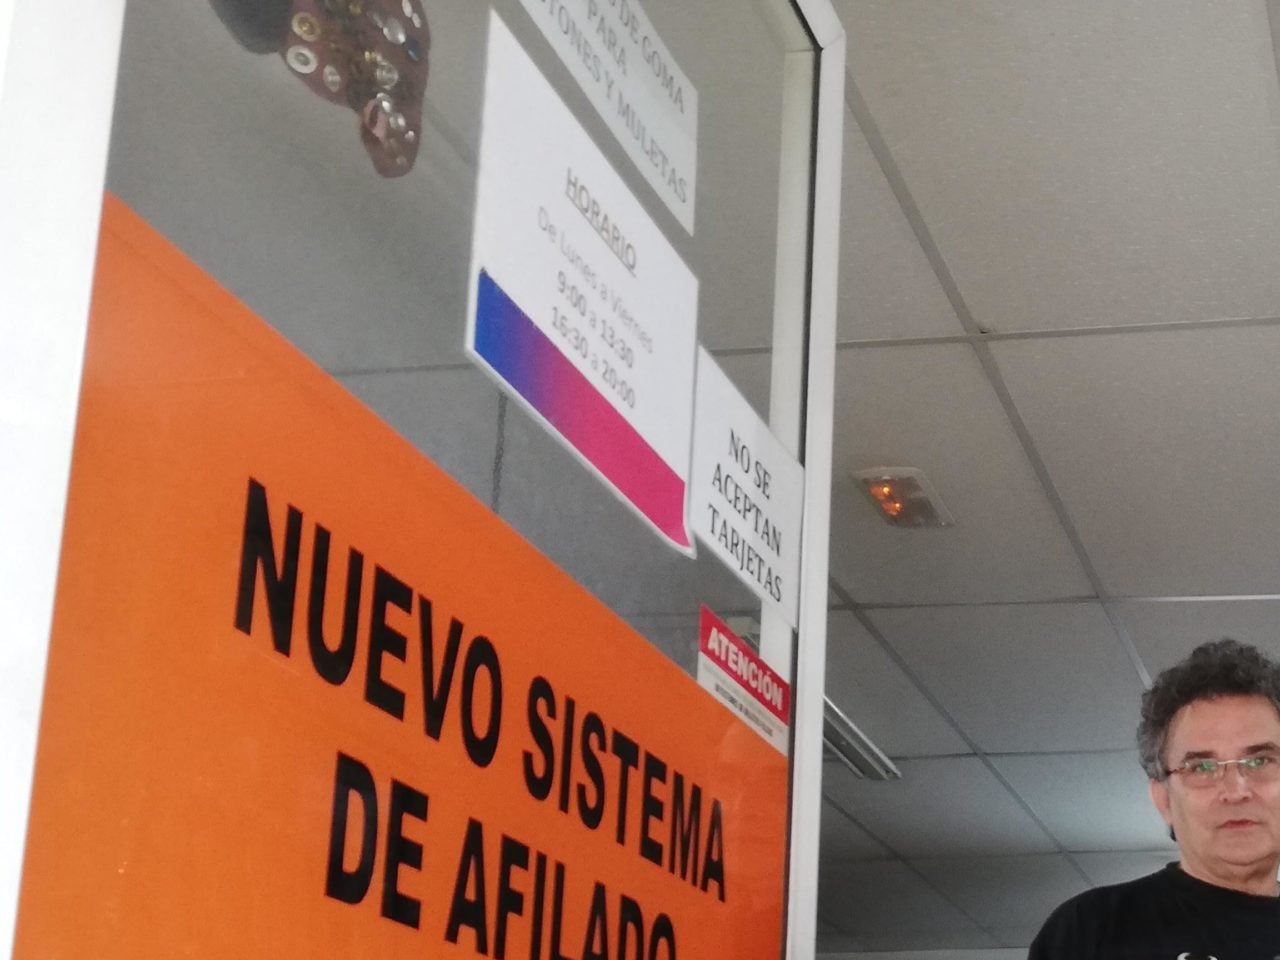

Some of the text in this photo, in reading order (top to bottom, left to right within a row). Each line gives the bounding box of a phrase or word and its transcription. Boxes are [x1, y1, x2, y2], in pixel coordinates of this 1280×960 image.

[587, 0, 627, 77] PARA
[619, 0, 685, 114] DE GOMA
[604, 70, 615, 100] Y
[618, 91, 687, 204] MULETAS
[565, 167, 637, 274] HORARIO
[538, 206, 653, 354] De Lunes a Viernes
[557, 270, 634, 368] 9:00 a 13:30
[551, 306, 636, 409] 16:30 a 20:00
[711, 463, 782, 558] ACEPTAN
[728, 427, 772, 500] NO SE
[707, 502, 783, 602] TARJETAS
[233, 476, 726, 903] NUEVO SISTEMA
[707, 626, 783, 711] ATENCIÓN
[324, 750, 430, 931] DE
